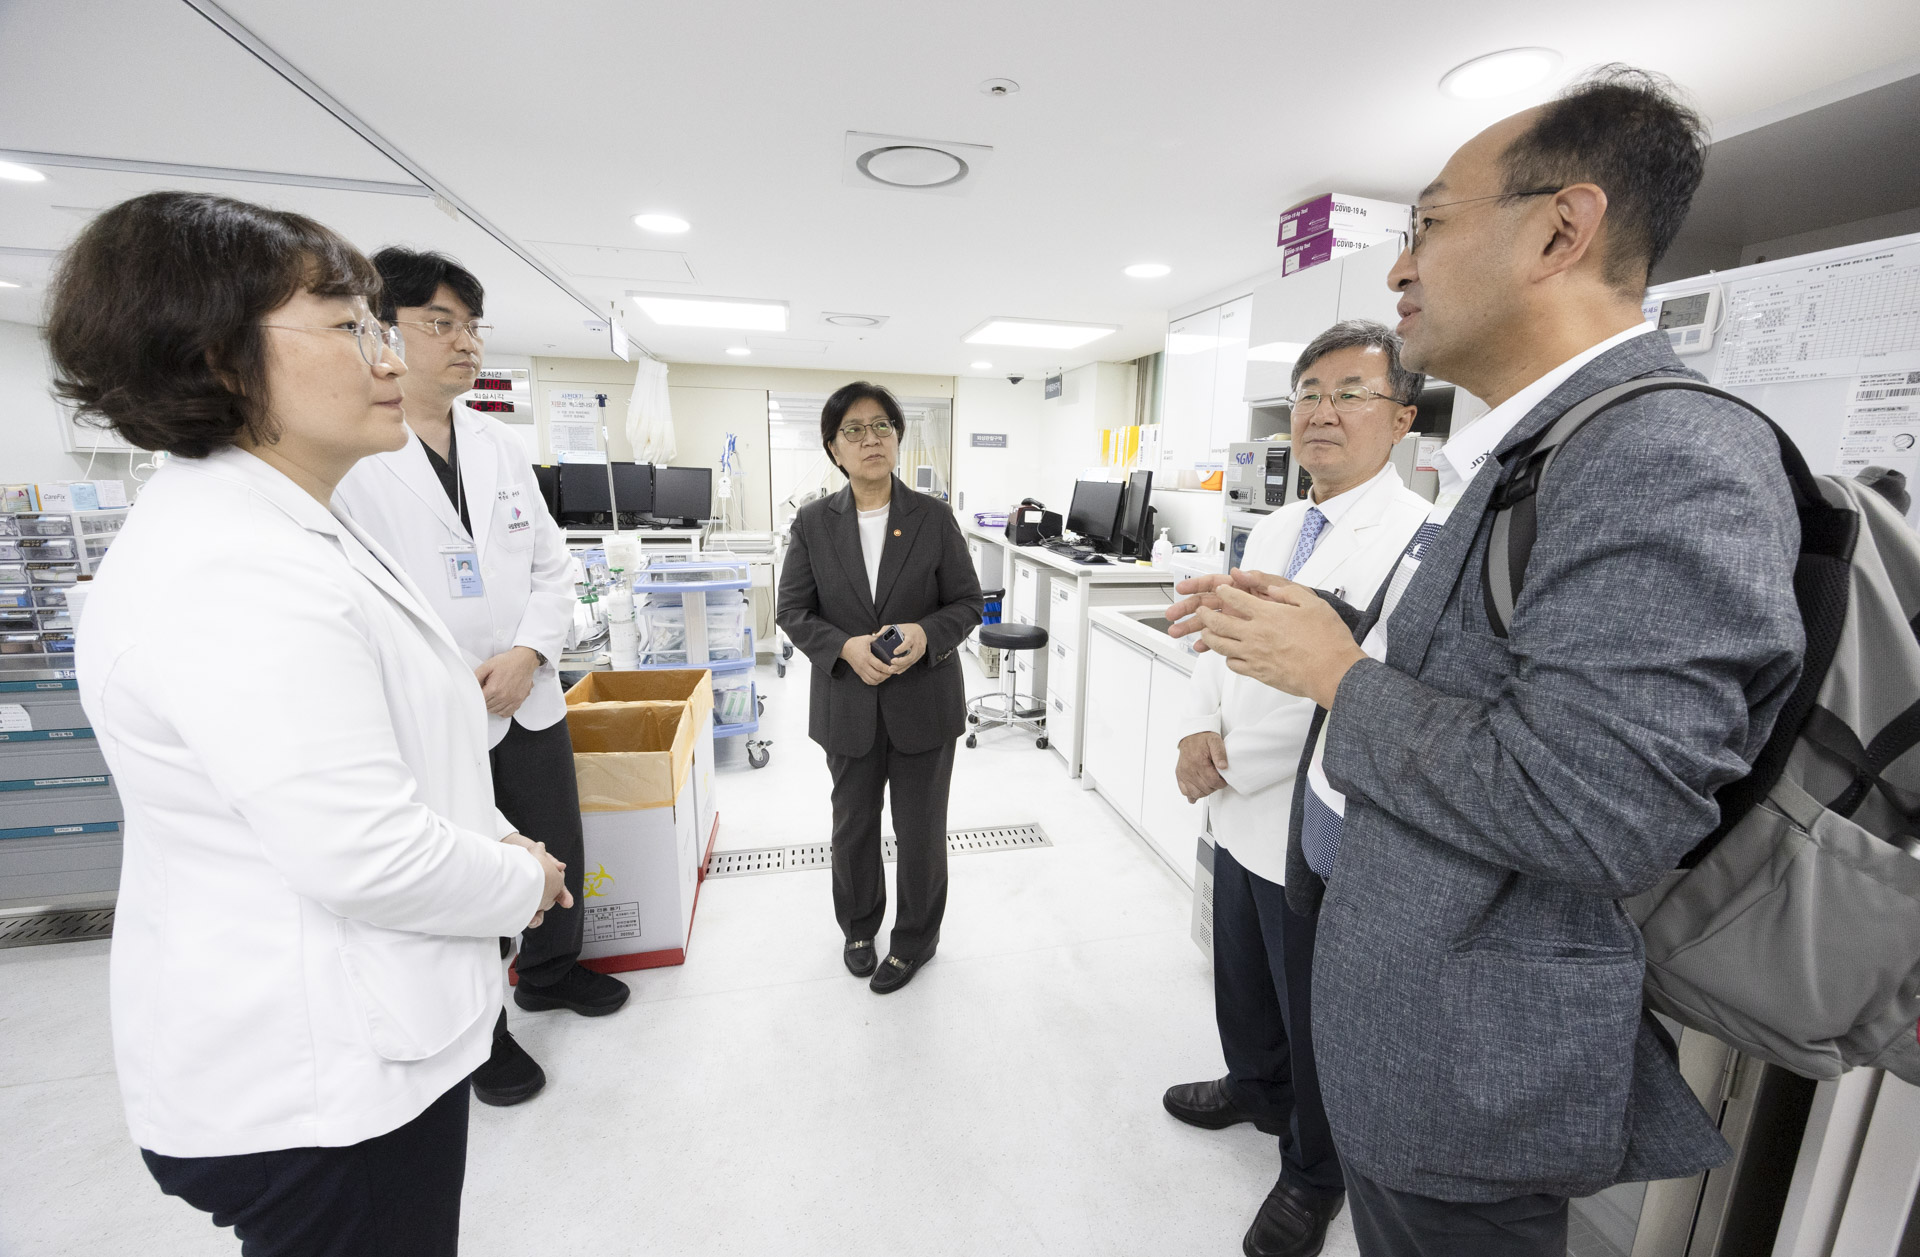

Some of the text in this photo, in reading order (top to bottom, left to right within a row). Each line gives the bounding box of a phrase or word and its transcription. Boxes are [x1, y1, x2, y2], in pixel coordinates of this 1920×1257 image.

[1335, 204, 1367, 217] COVID-19 Ag
[1336, 240, 1362, 250] COVID-19
[484, 379, 500, 390] 00
[487, 401, 502, 412] 58
[1235, 452, 1255, 465] SGM
[1470, 449, 1490, 470] JDX
